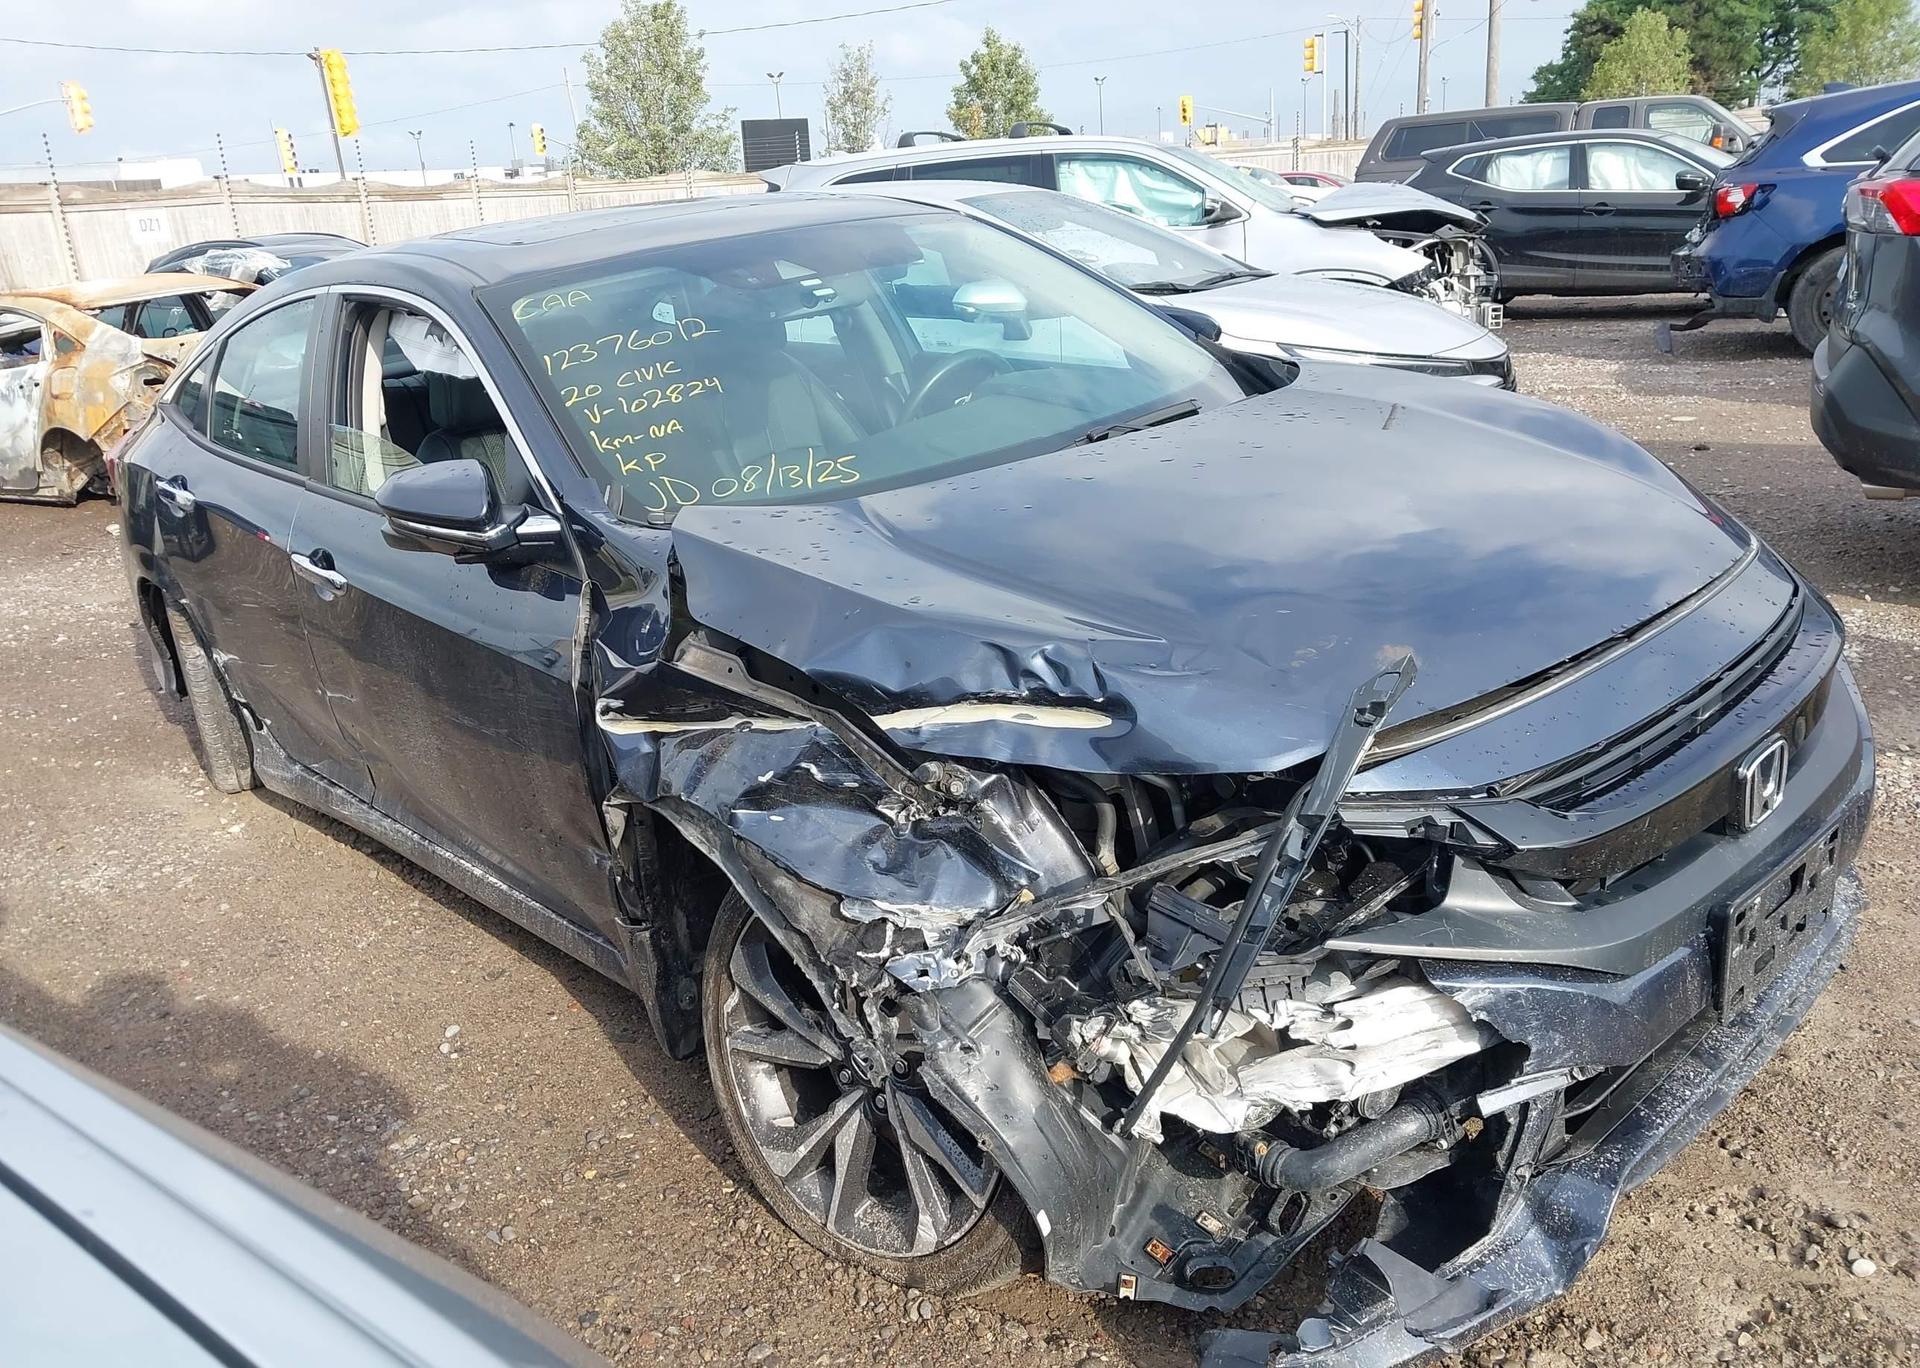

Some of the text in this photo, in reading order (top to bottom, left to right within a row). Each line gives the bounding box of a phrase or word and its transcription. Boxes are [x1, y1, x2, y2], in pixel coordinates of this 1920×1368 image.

[512, 289, 592, 321] CAA
[543, 317, 723, 375] 12376012
[560, 383, 602, 407] 20
[643, 447, 861, 513] JD 08/13/25
